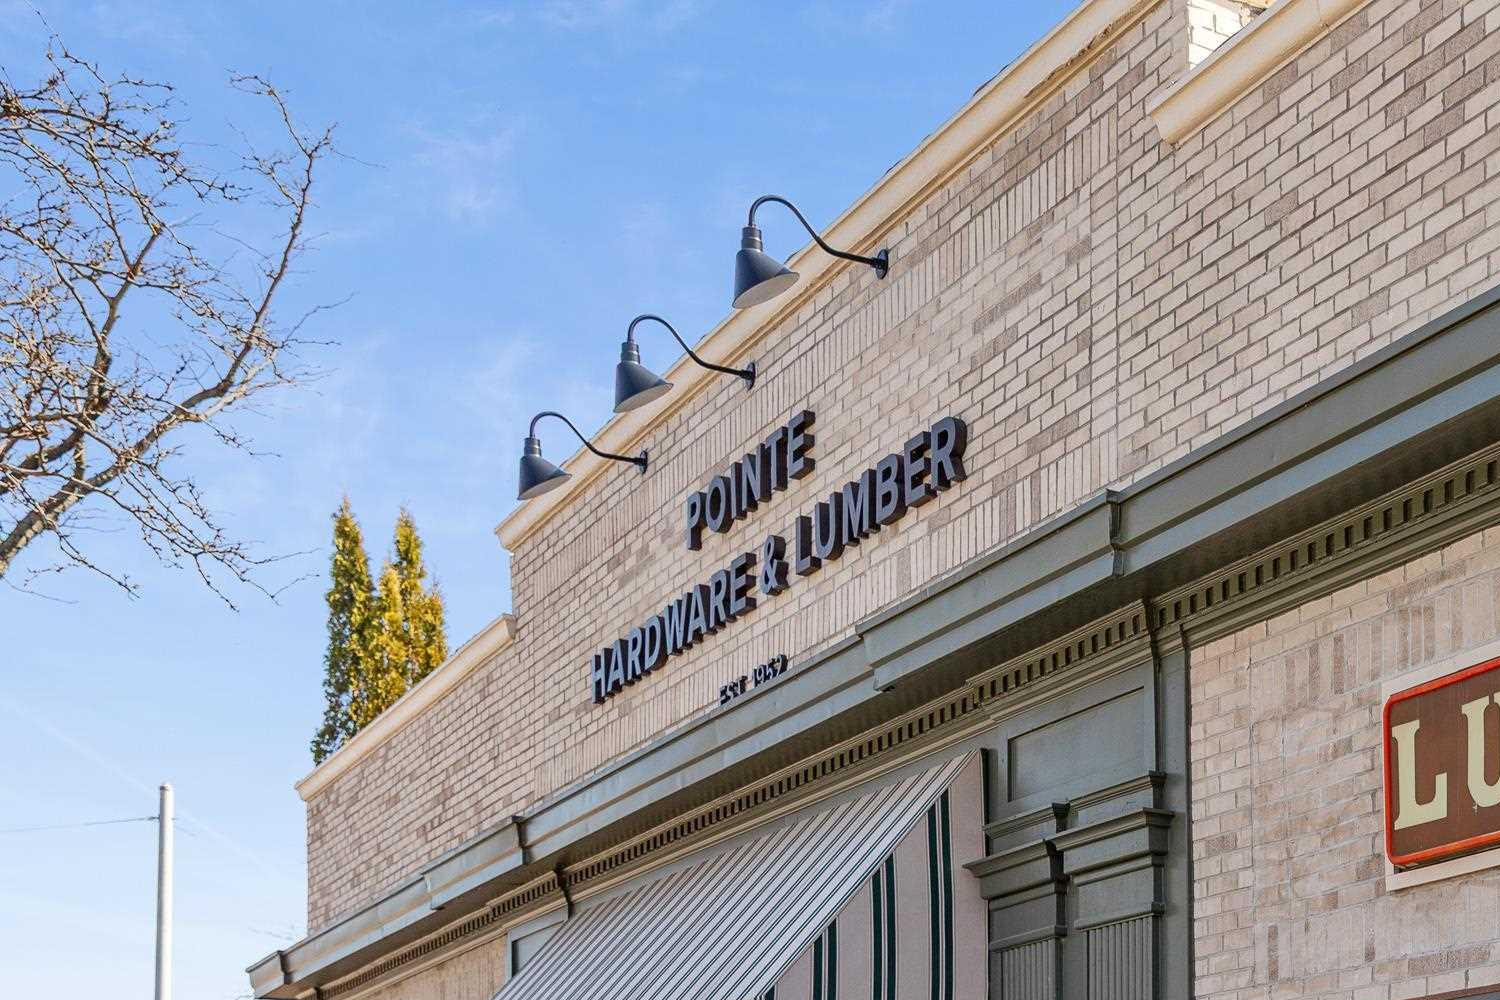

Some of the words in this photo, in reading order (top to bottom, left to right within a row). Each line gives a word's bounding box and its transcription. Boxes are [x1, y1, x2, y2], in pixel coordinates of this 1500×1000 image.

[591, 552, 757, 704] HARDWARE
[760, 535, 789, 596] &
[795, 416, 968, 576] LUMBER
[686, 410, 815, 551] POINTE
